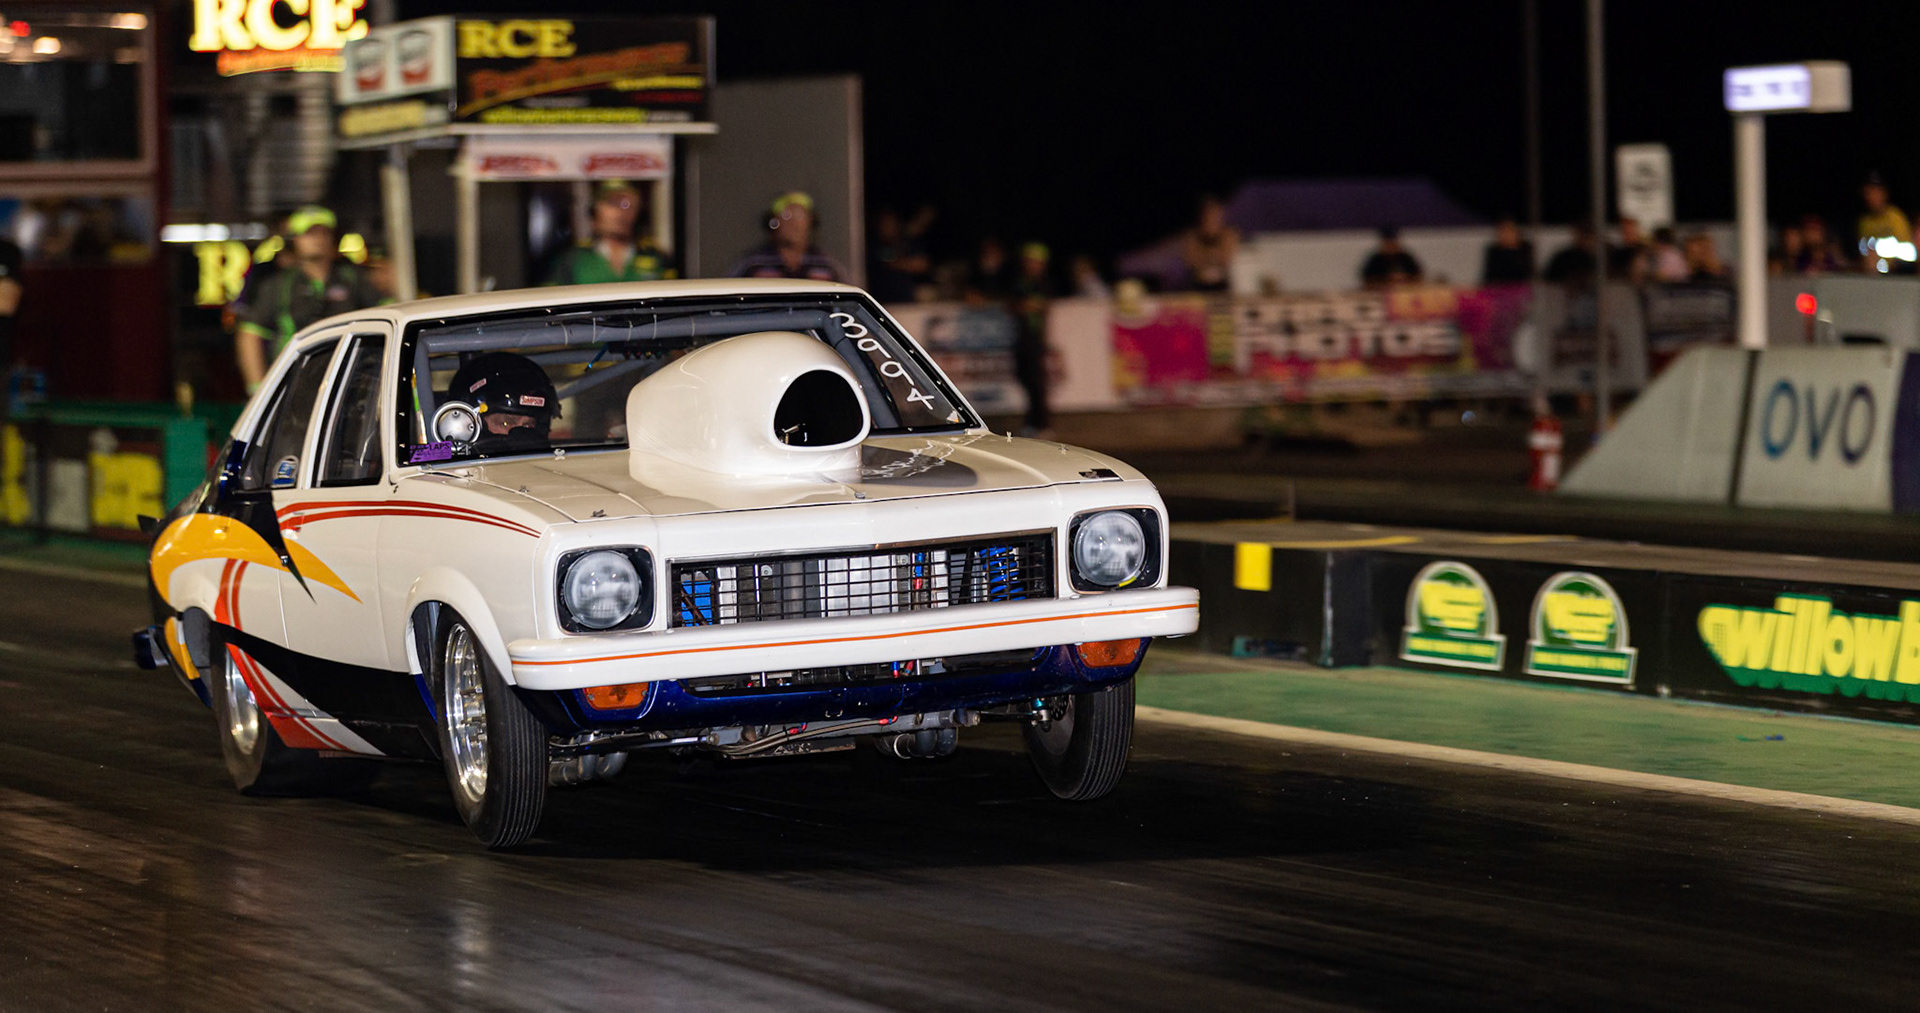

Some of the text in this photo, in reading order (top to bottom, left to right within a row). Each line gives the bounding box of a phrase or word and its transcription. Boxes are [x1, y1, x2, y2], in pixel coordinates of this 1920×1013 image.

[188, 0, 369, 51] RCE
[457, 19, 576, 58] RCE
[1761, 379, 1877, 466] OVO
